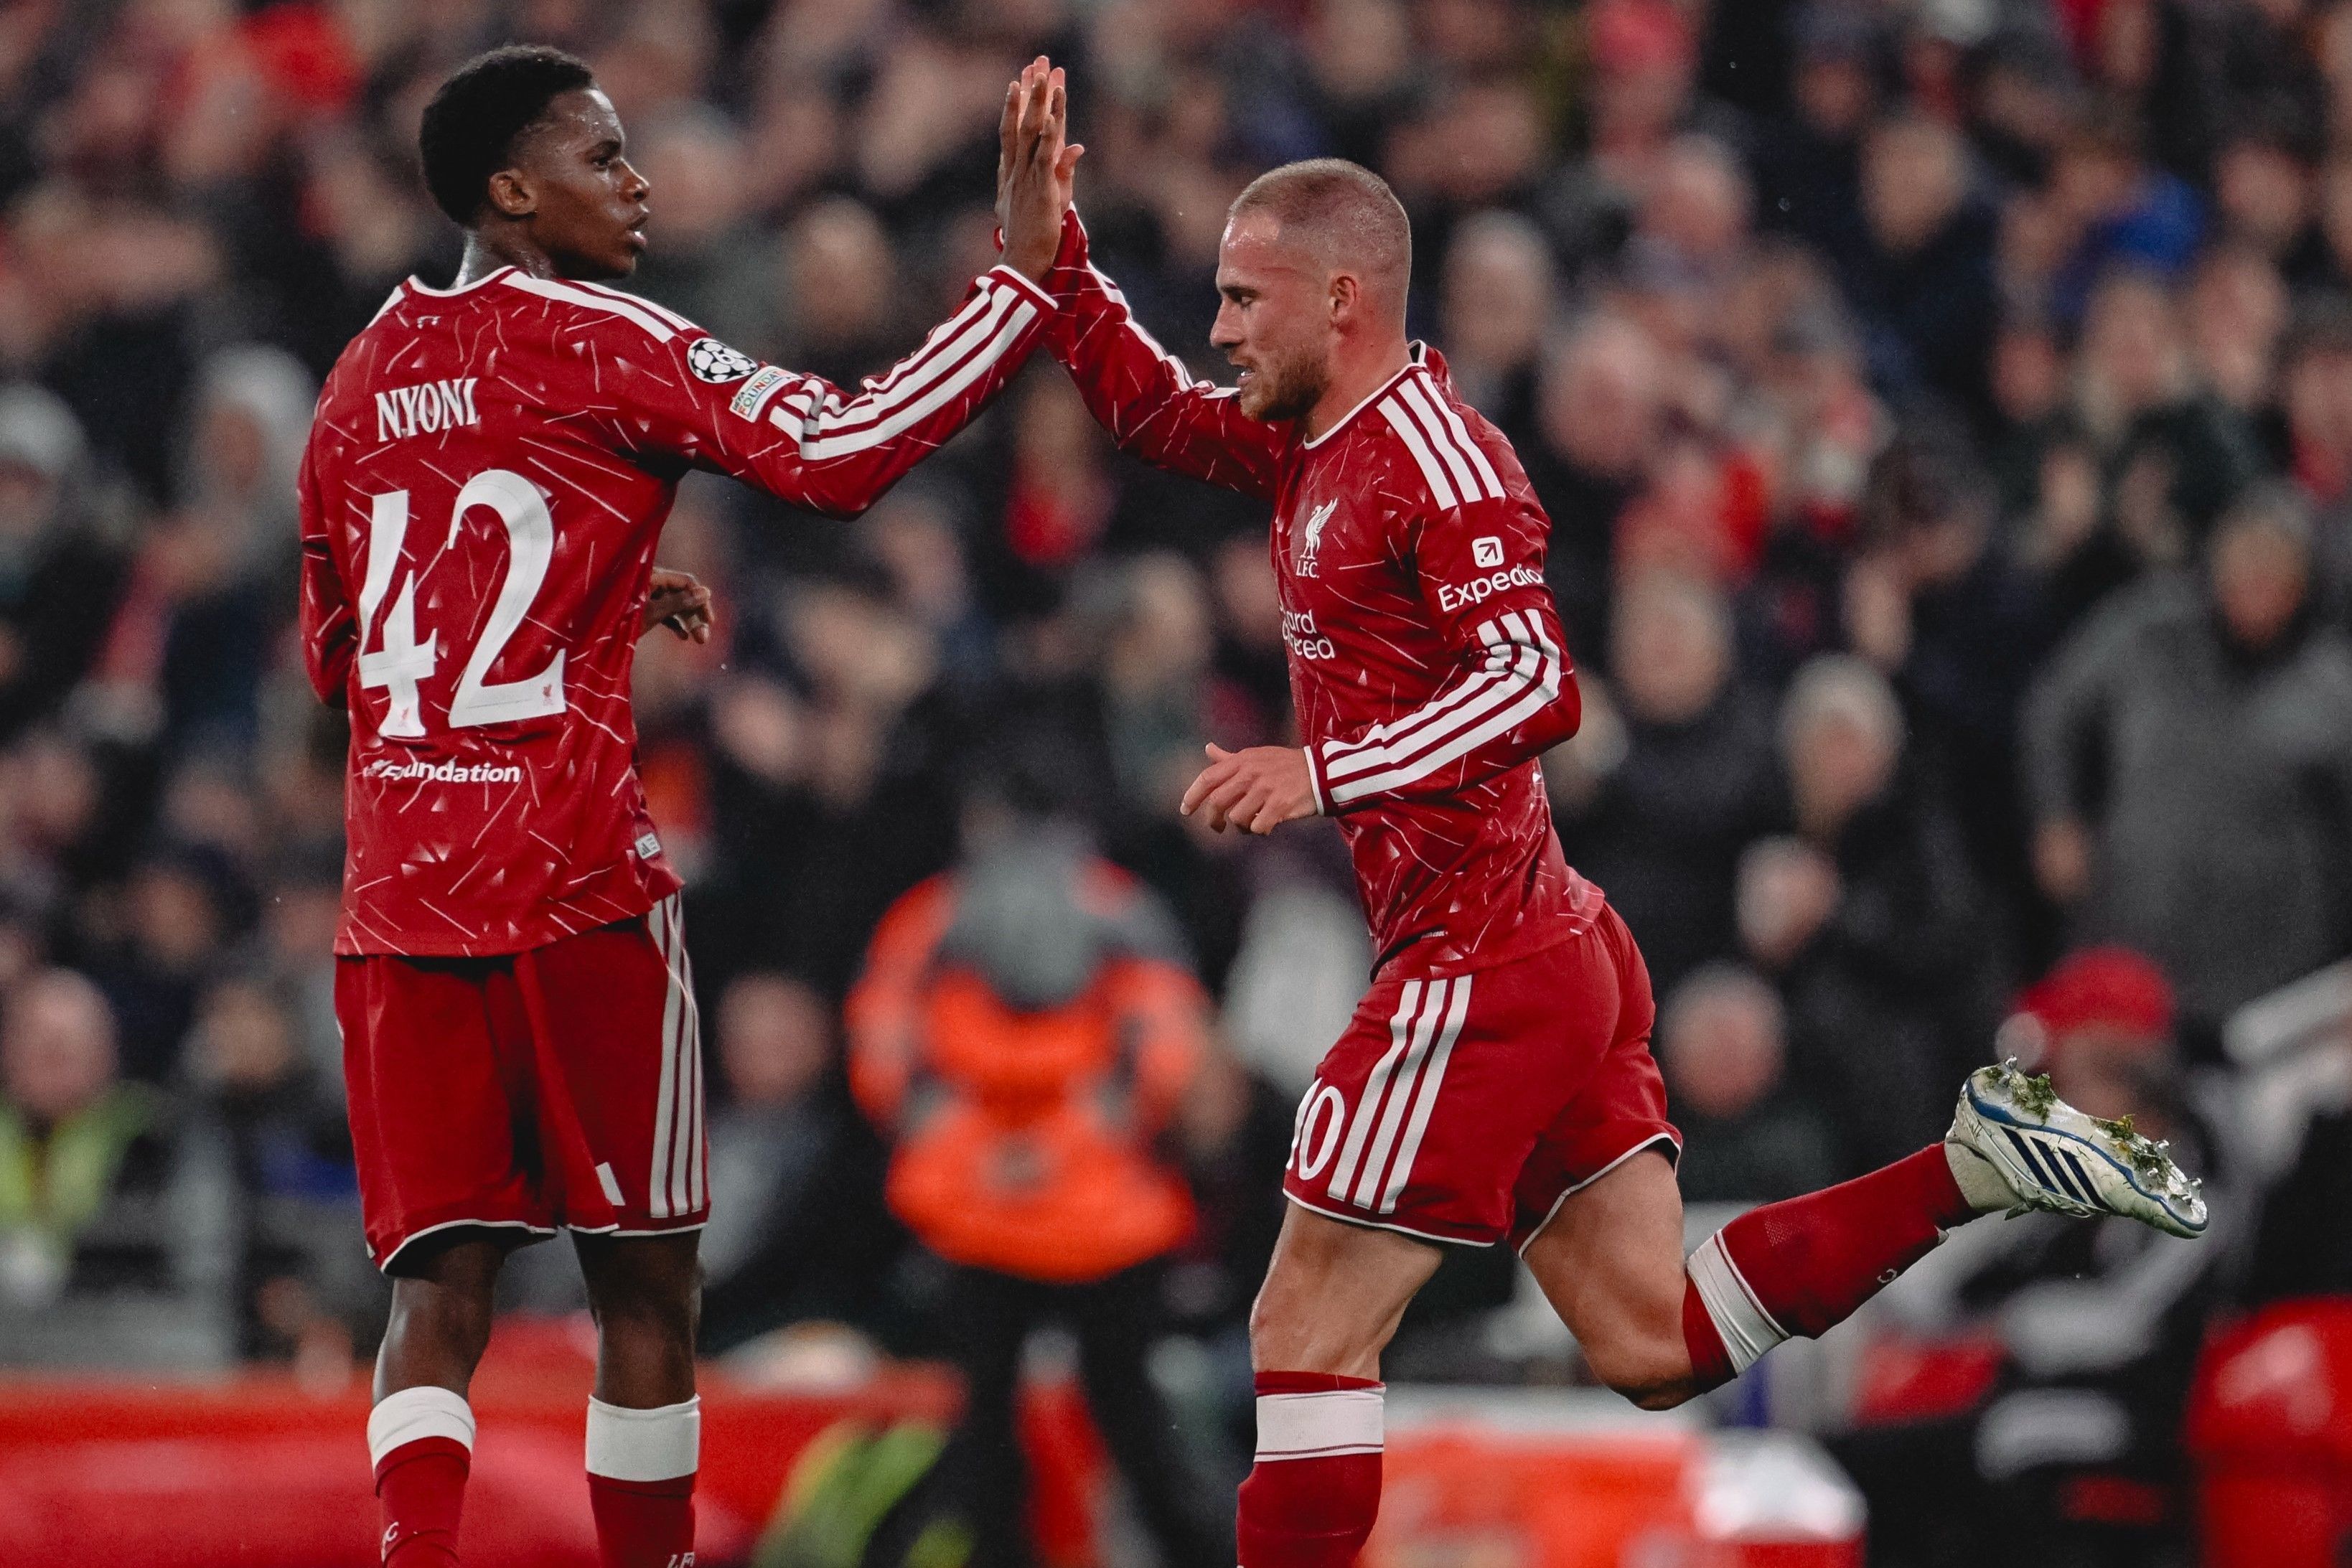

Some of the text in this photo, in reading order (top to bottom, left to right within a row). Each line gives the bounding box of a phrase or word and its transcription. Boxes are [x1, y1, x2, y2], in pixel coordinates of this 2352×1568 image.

[375, 377, 479, 443] NYONI
[360, 469, 566, 738] 42
[1438, 563, 1543, 612] Expedia
